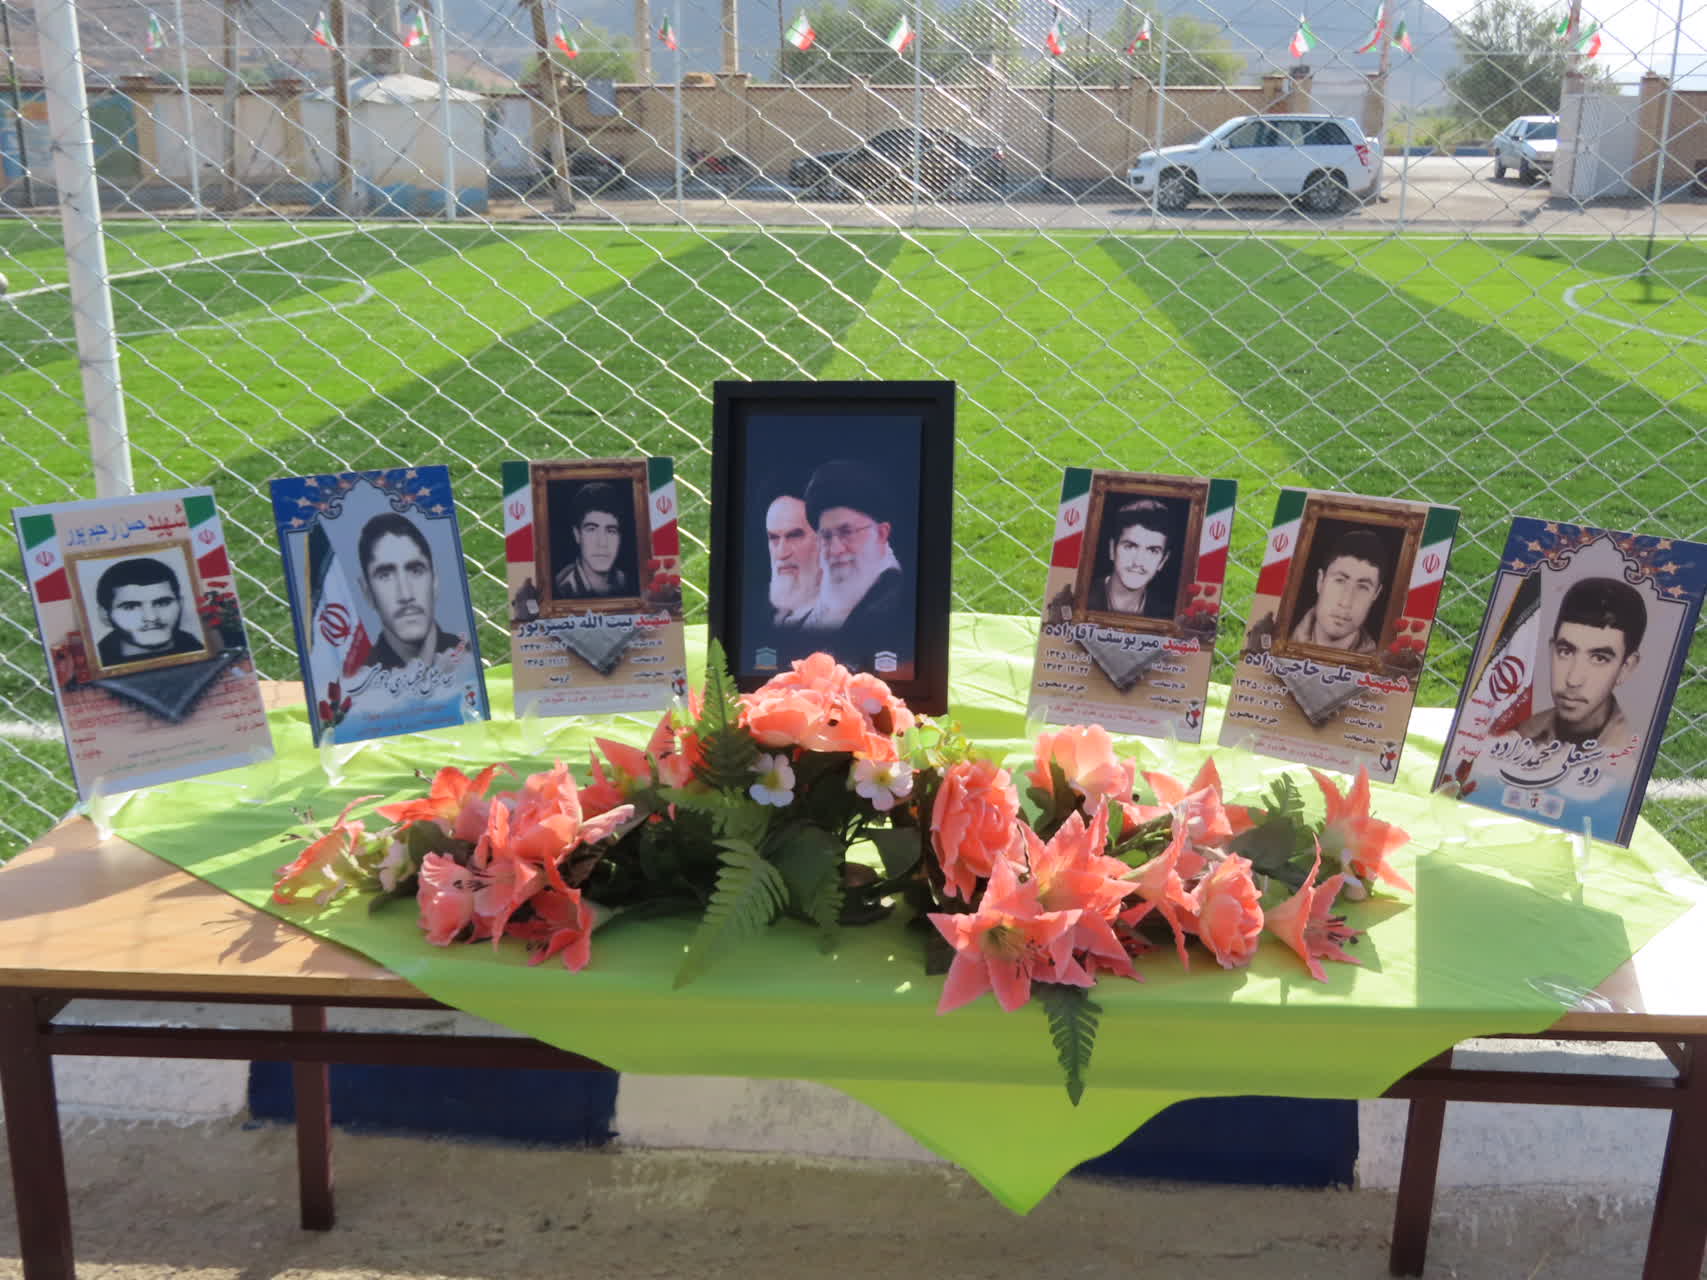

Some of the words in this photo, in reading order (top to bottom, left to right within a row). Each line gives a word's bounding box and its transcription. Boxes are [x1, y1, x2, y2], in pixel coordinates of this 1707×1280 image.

[580, 611, 603, 629] الله
[607, 616, 633, 631] بیت
[635, 612, 671, 631] شهید
[1163, 638, 1199, 654] شهید
[1321, 666, 1353, 685] علی
[1357, 674, 1410, 694] شهید
